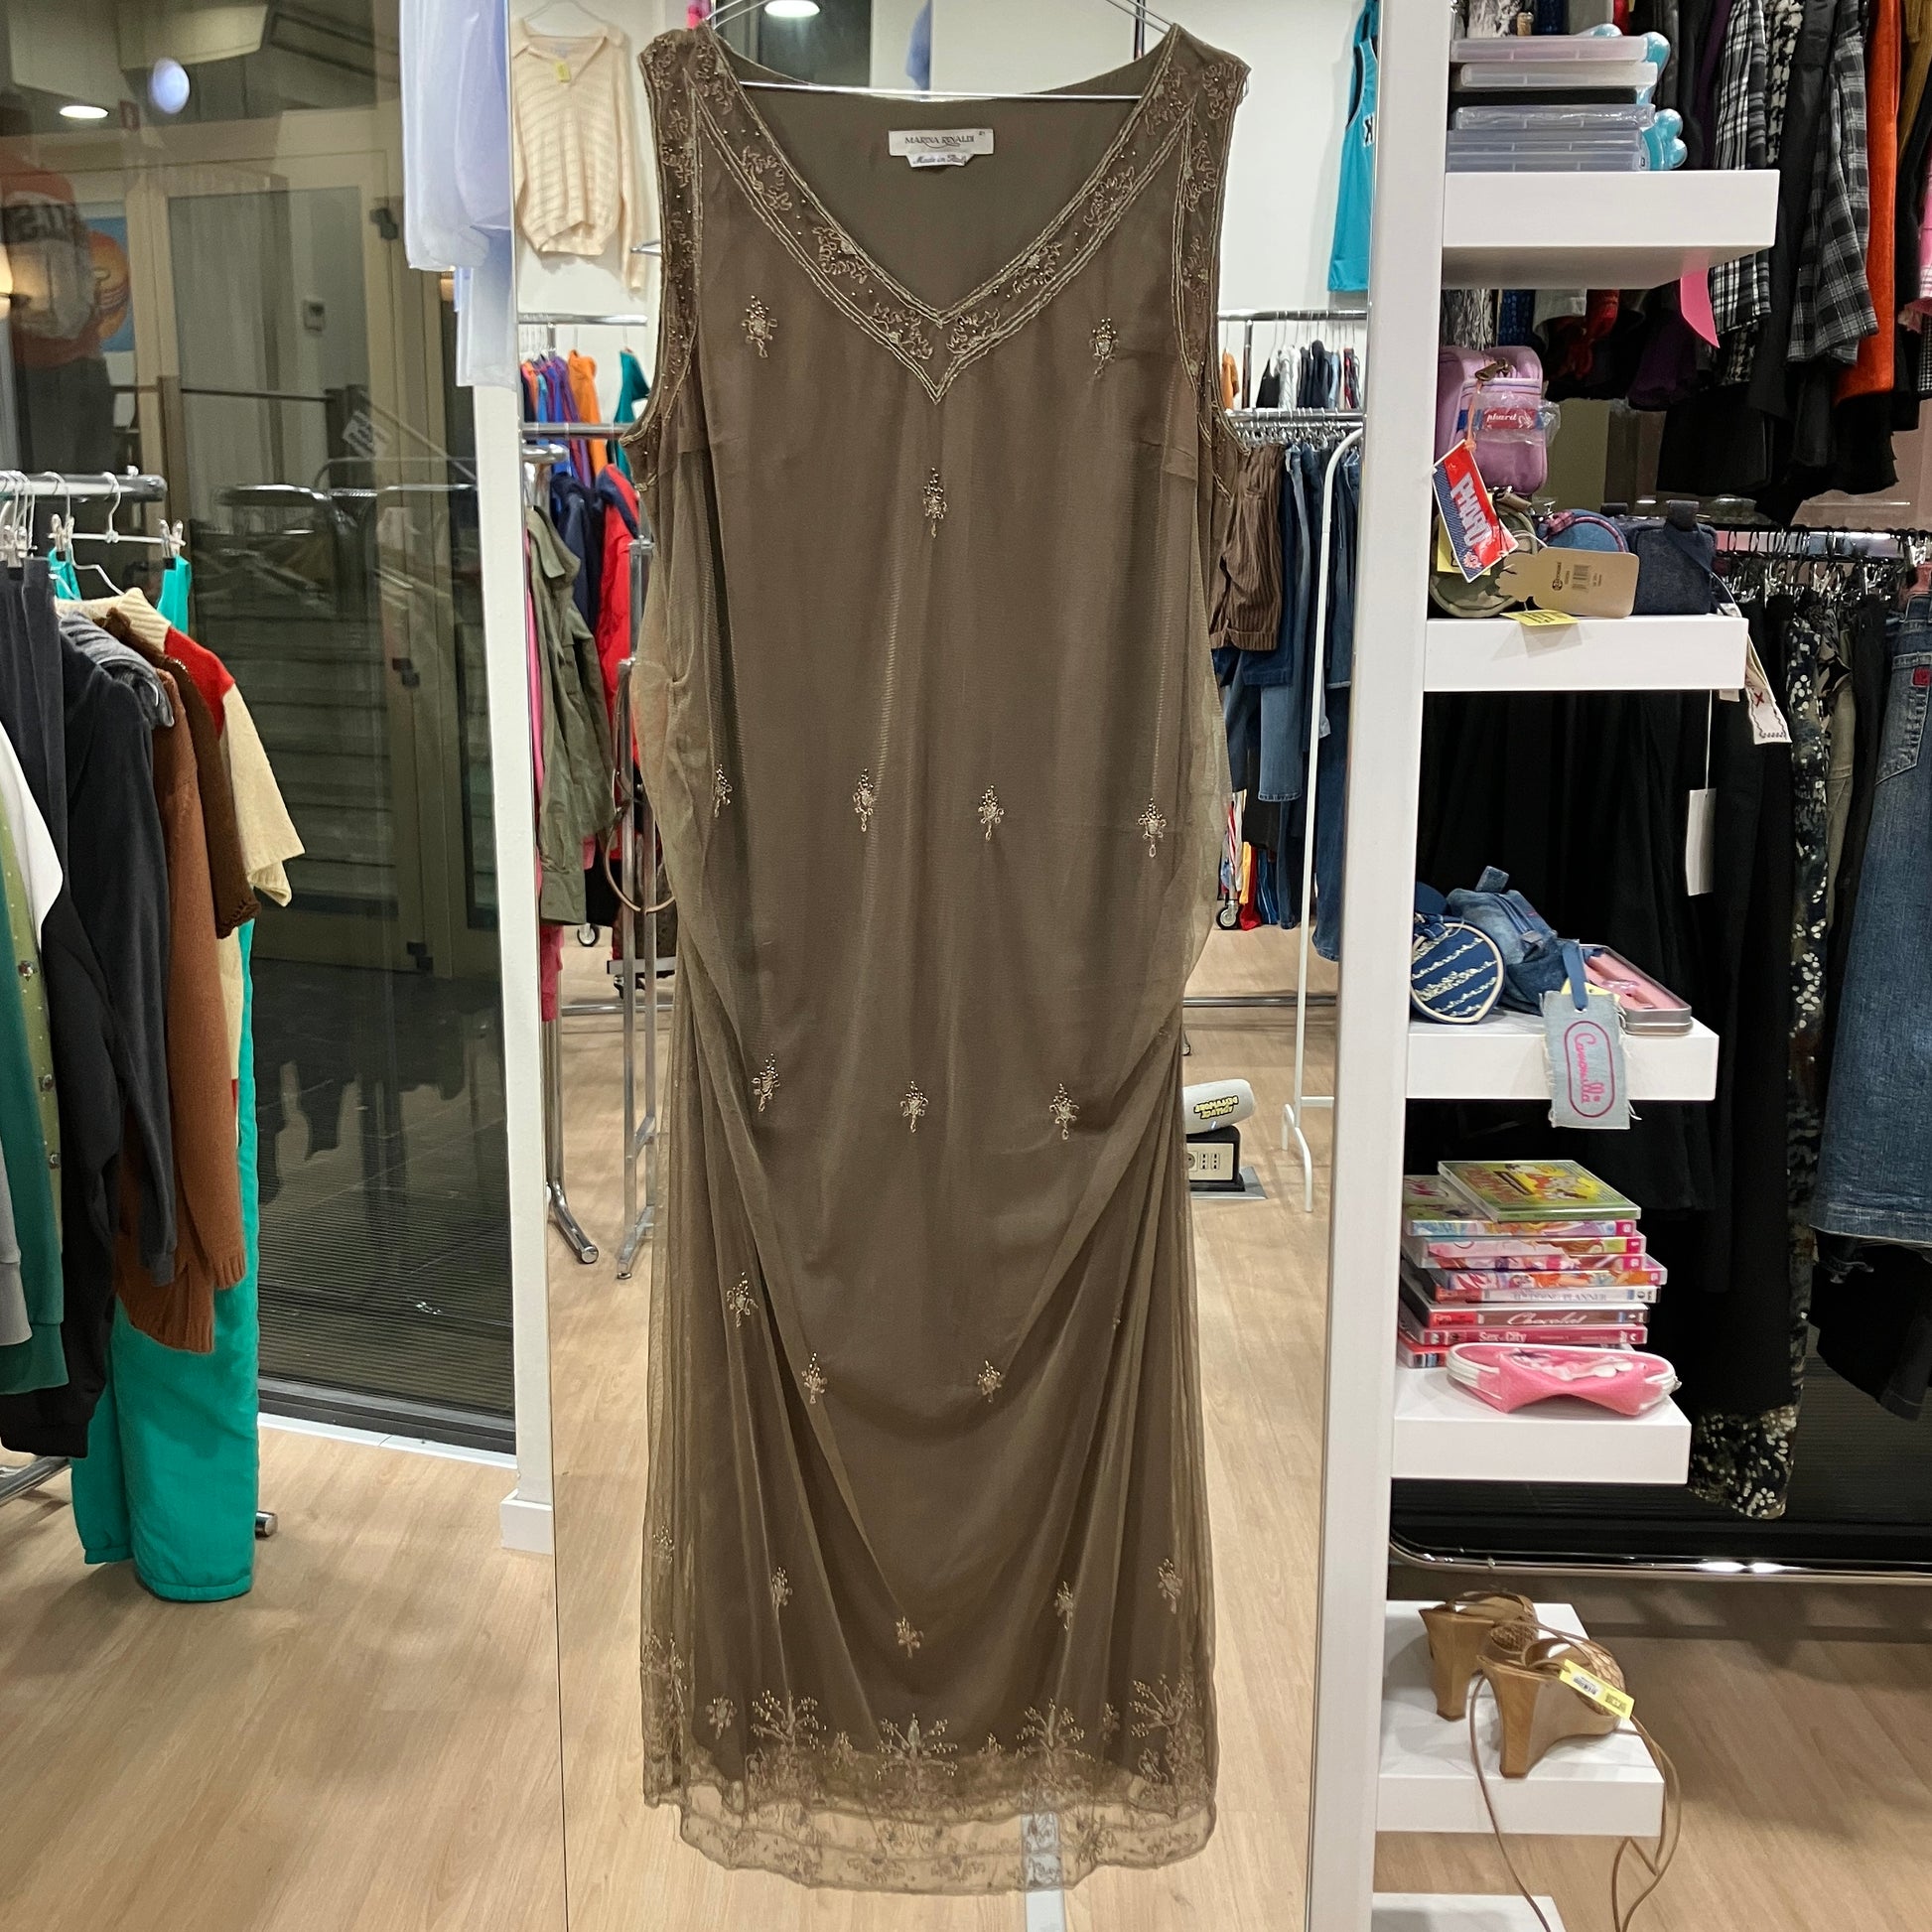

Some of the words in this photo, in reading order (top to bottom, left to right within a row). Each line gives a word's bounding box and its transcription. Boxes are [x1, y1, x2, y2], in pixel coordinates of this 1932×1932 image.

[904, 136, 939, 145] MARINA
[941, 135, 975, 145] RINALDI
[913, 155, 935, 164] Made
[1486, 412, 1517, 422] phard
[1450, 472, 1492, 548] PHARD
[1562, 1292, 1606, 1301] PLANNER
